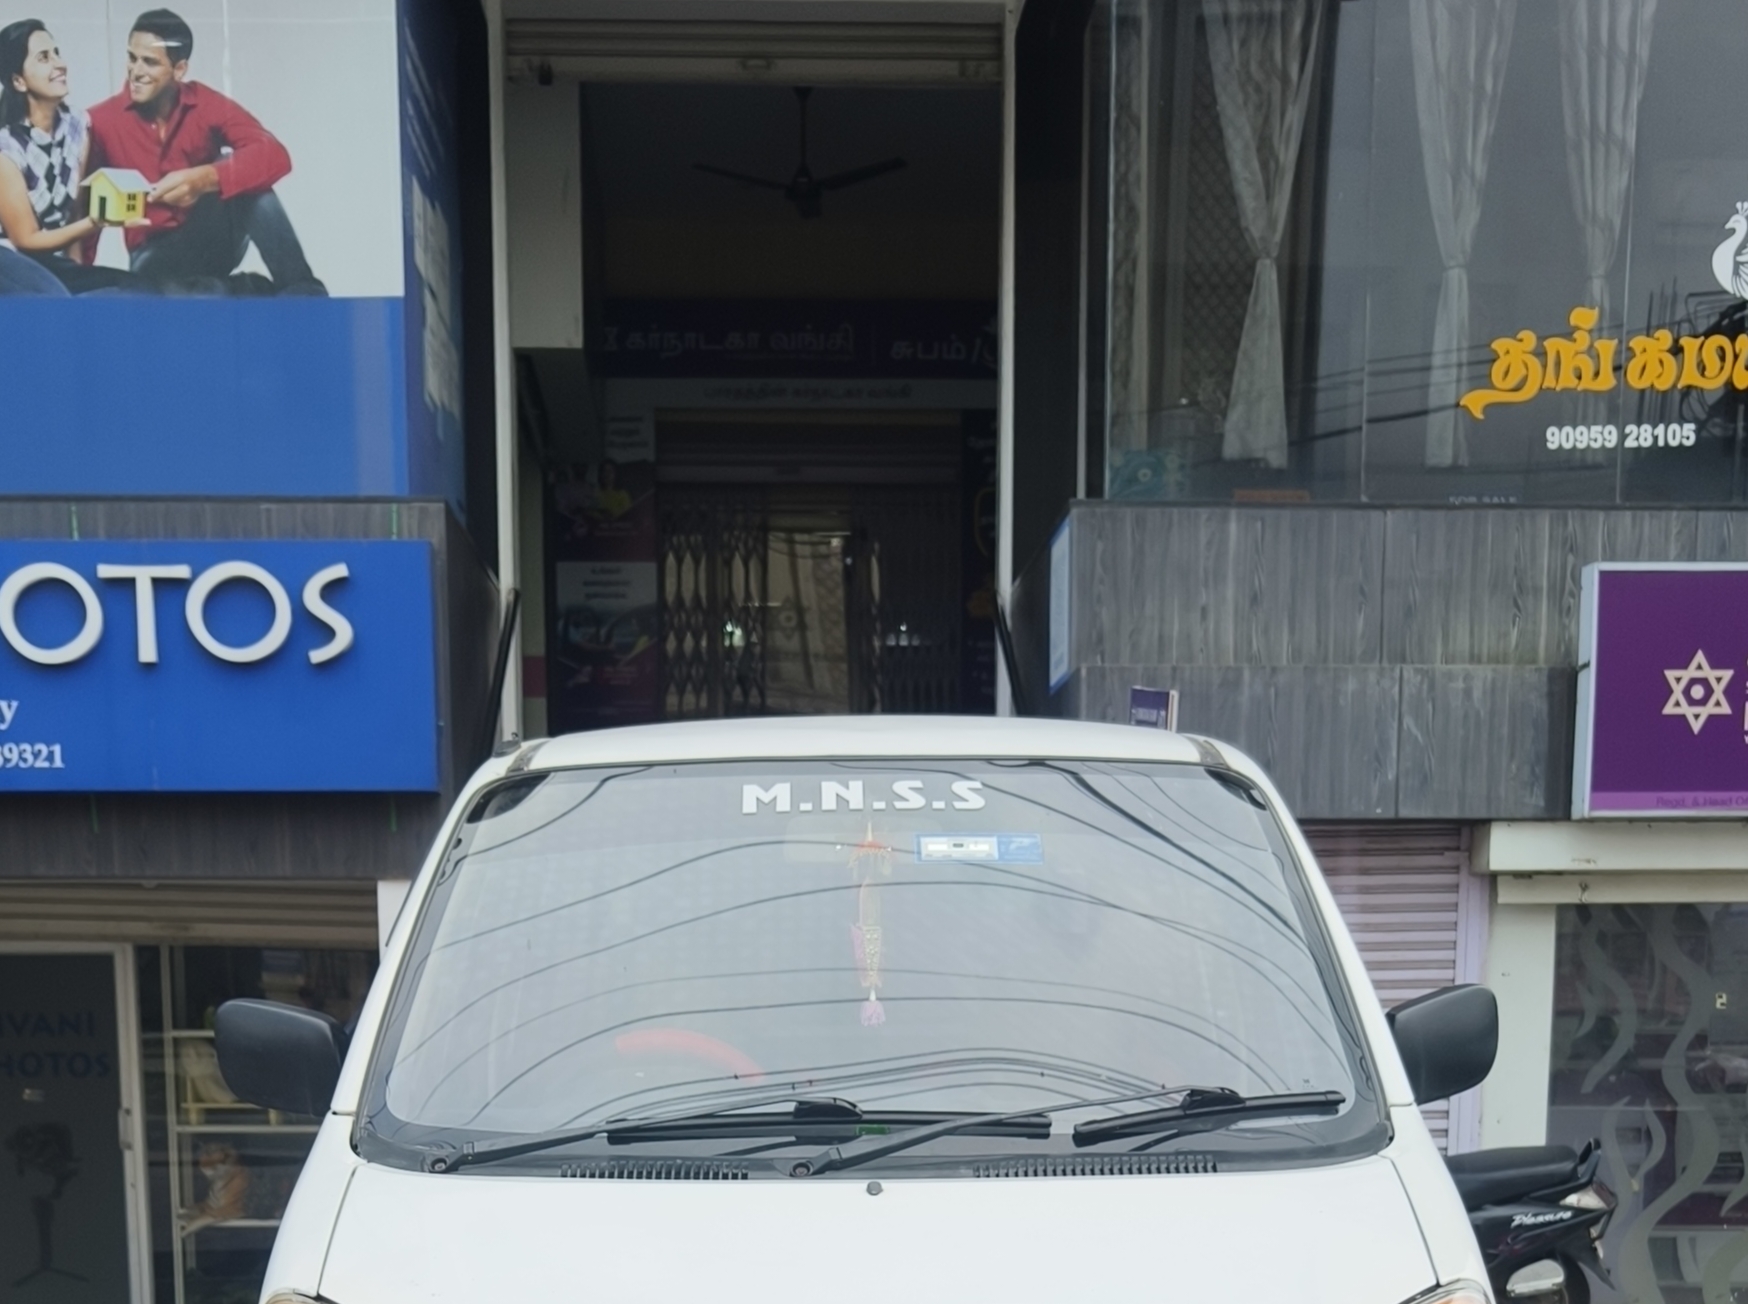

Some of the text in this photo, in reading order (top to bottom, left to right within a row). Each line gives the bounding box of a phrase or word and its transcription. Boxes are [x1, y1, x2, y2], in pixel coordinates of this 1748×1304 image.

[1545, 422, 1697, 450] 90959 28105
[0, 742, 66, 769] 9321
[741, 780, 987, 815] M.N.S.S
